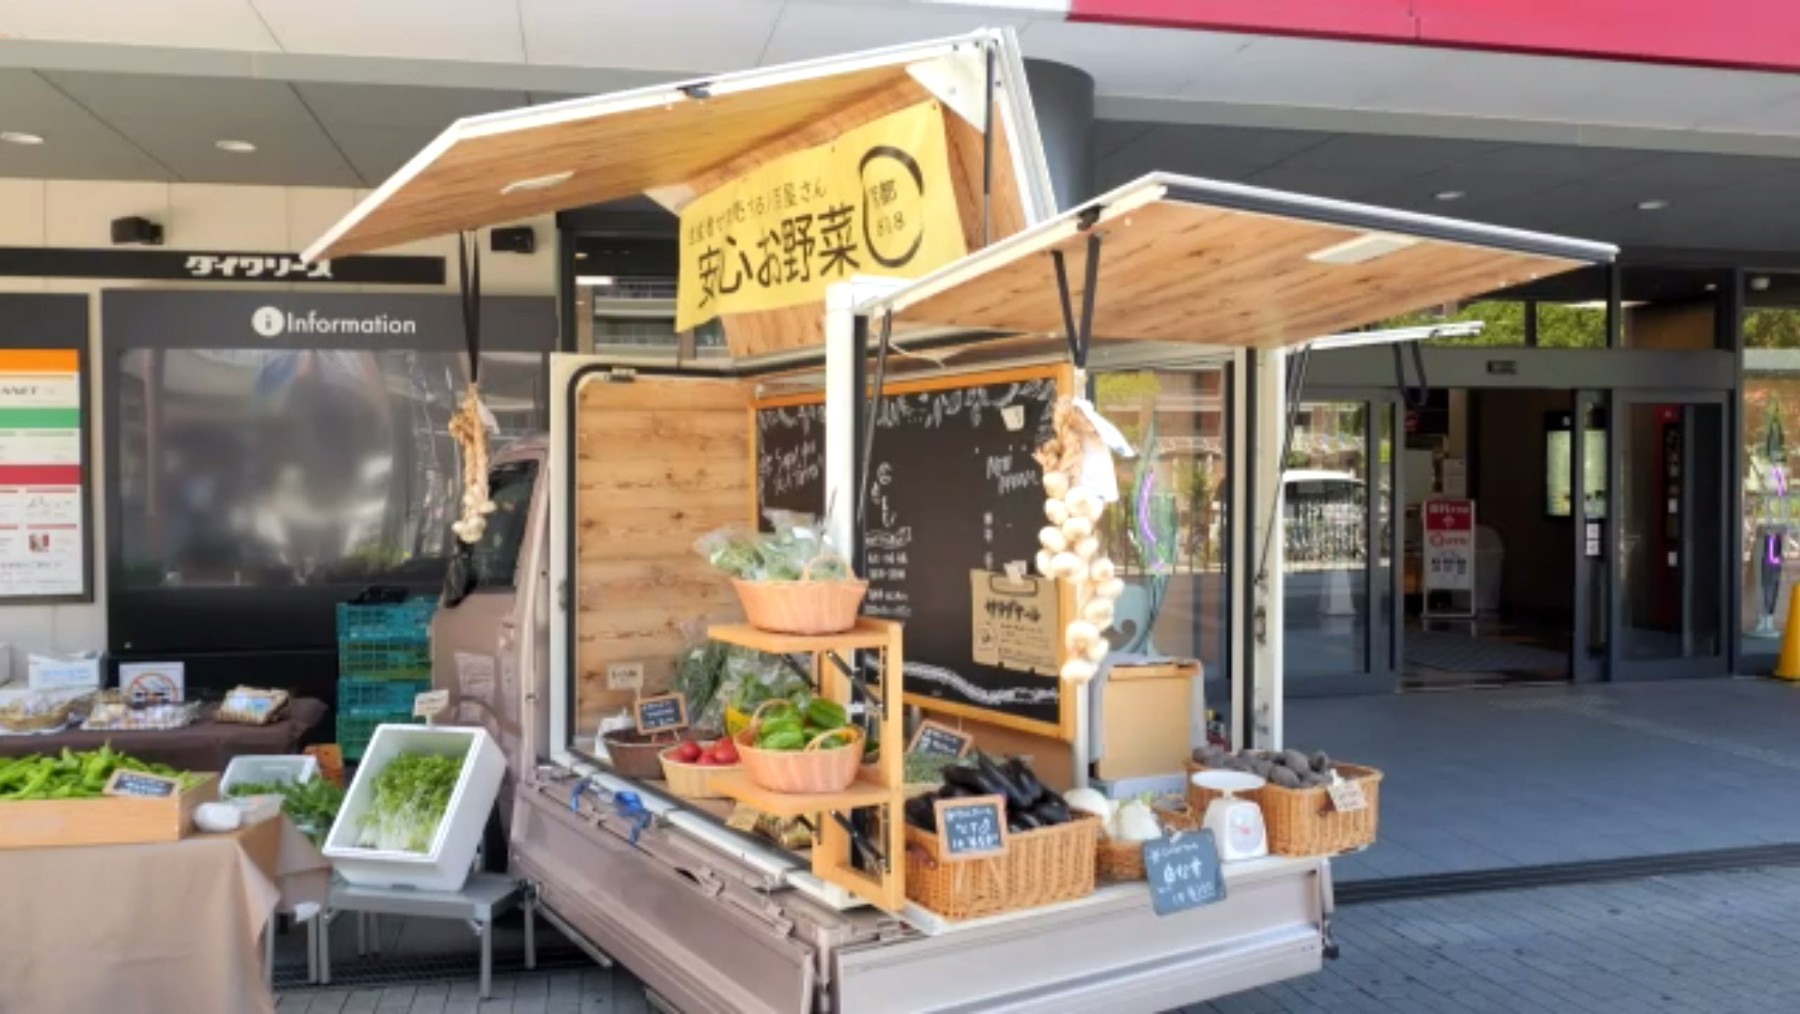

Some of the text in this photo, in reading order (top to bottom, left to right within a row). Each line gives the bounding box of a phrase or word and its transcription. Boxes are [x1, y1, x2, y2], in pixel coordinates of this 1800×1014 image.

[184, 255, 333, 278] ダイワリース
[697, 202, 860, 308] 安心お野菜
[287, 309, 417, 334] Information
